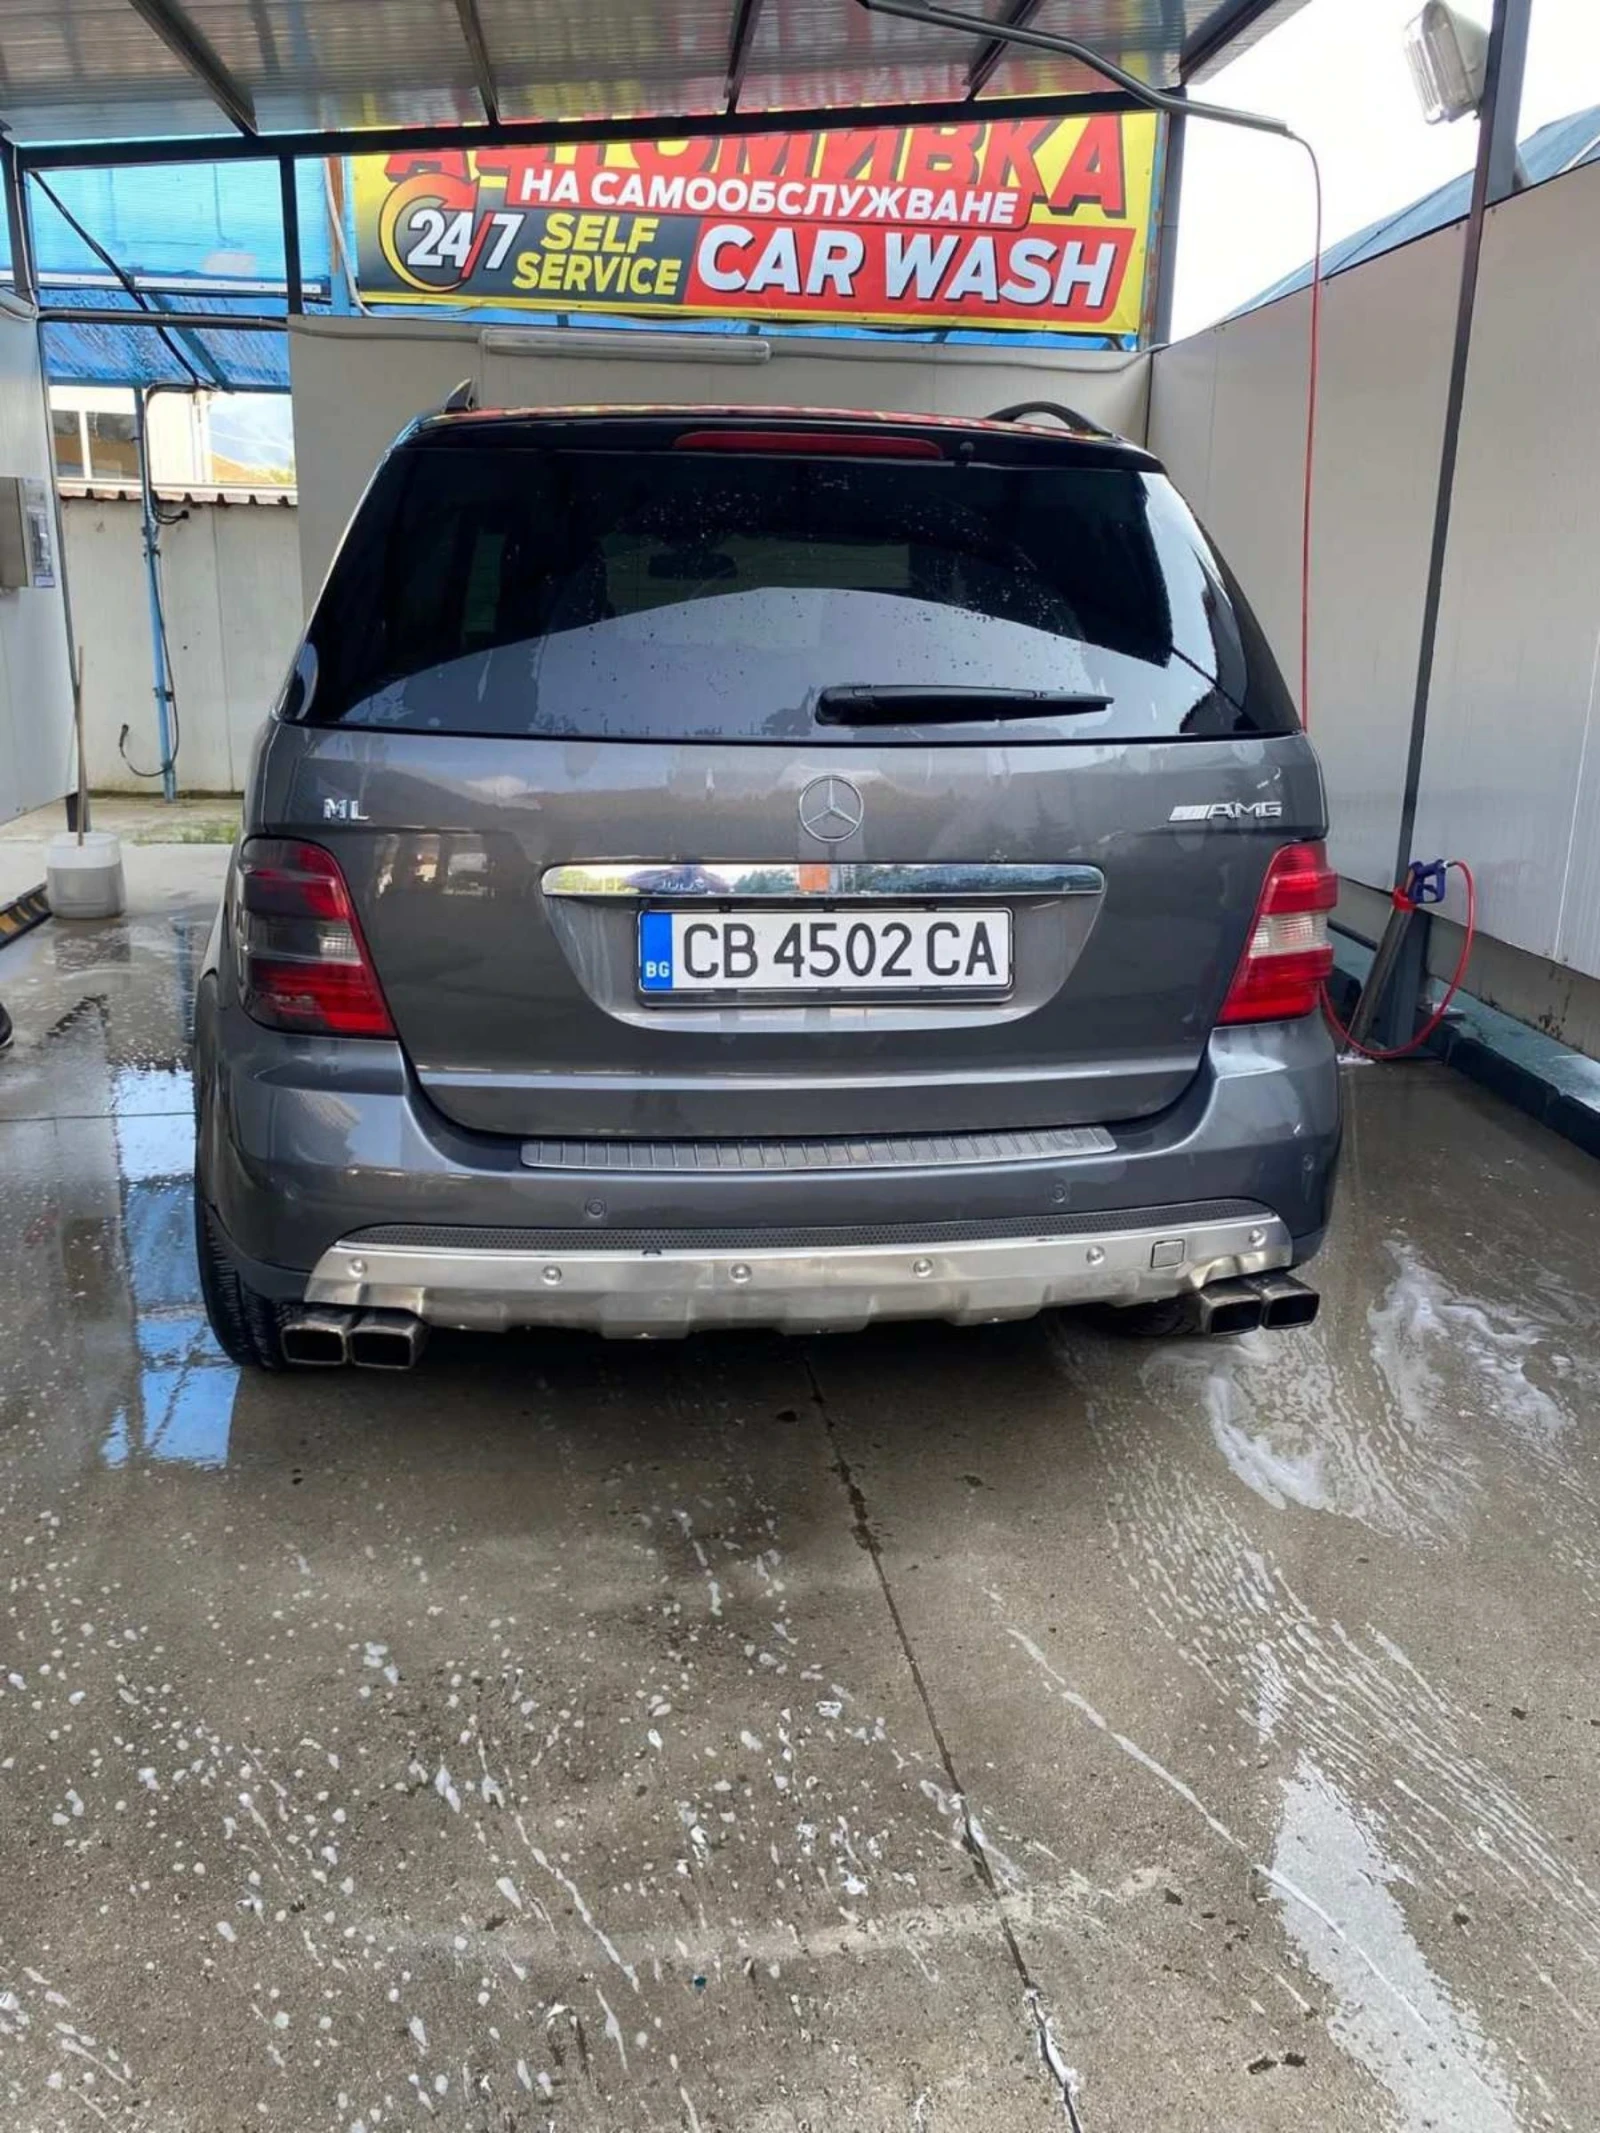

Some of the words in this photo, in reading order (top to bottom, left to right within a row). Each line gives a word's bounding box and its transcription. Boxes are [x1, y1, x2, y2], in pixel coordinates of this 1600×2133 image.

[520, 168, 580, 203] НА
[591, 172, 1018, 224] САМООБСЛУЖВАНЕ
[407, 209, 525, 280] 24/7
[540, 212, 660, 254] SELF
[512, 252, 682, 296] SERVICE
[697, 224, 865, 297] CAR
[884, 231, 1117, 307] WASH
[323, 798, 370, 820] ML
[1207, 801, 1283, 820] AMG
[646, 961, 670, 978] BG
[684, 922, 758, 978] CB
[773, 922, 912, 978] 4502
[926, 921, 997, 977] CA
